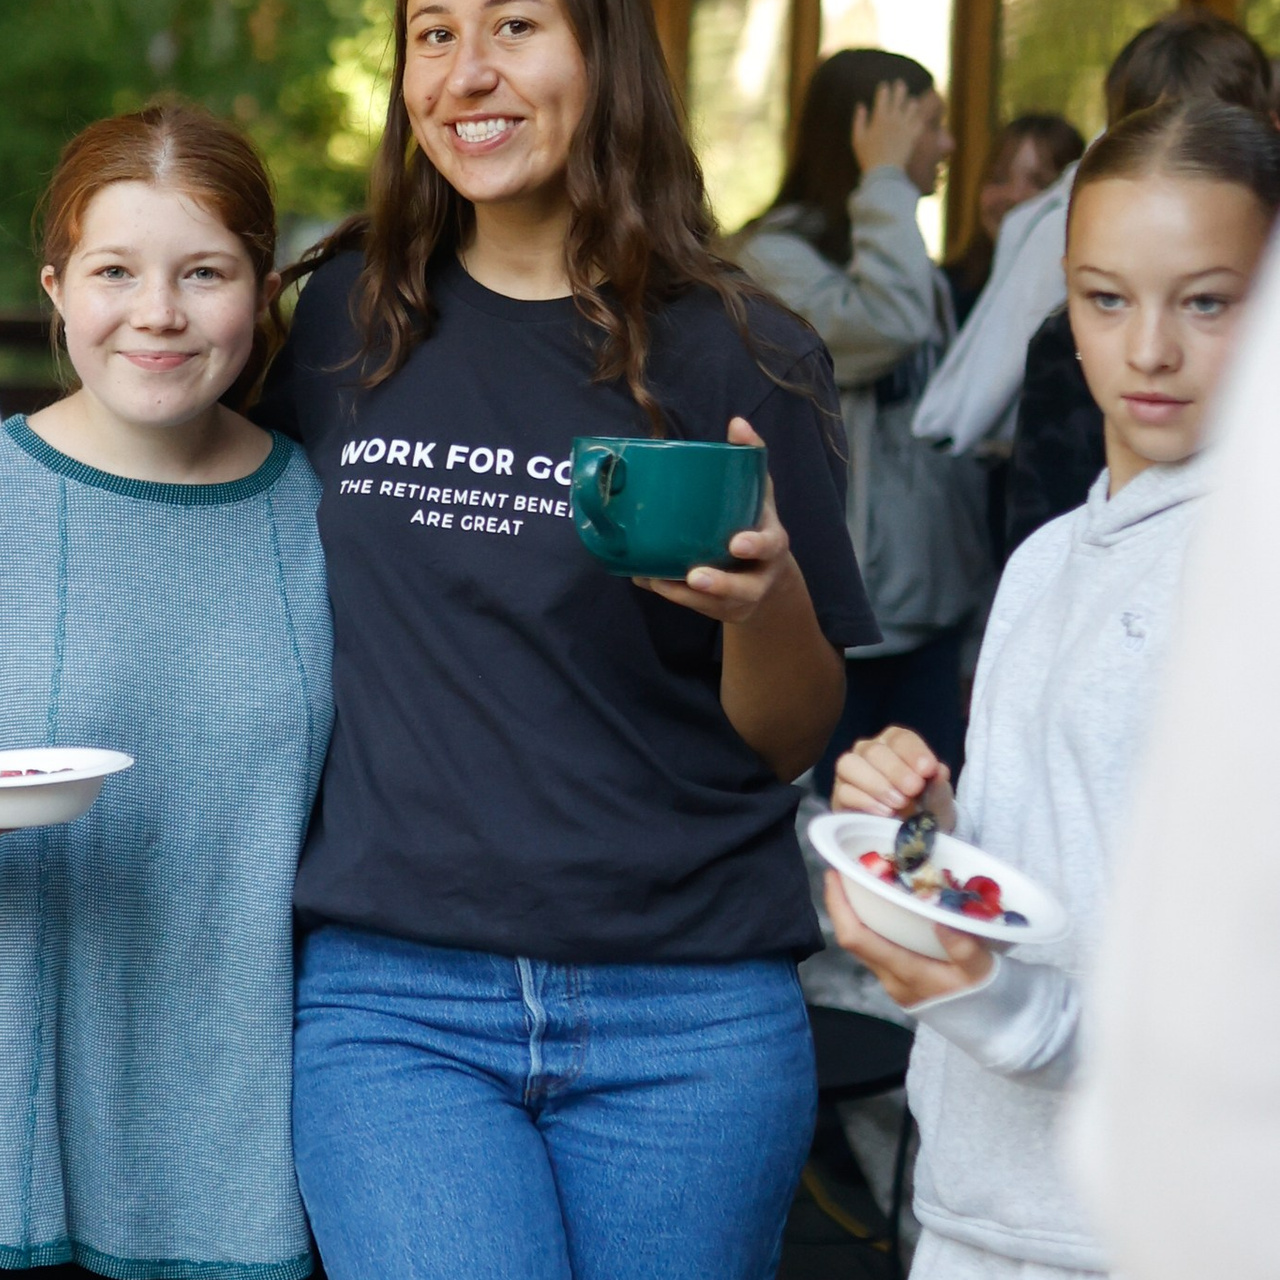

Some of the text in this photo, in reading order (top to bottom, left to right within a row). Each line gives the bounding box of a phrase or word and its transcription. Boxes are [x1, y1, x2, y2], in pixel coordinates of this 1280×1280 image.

[340, 438, 437, 469] WORK
[445, 444, 515, 476] FOR
[339, 479, 373, 495] THE
[379, 481, 509, 509] RETIREMENT
[410, 509, 524, 537] ARE GREAT
